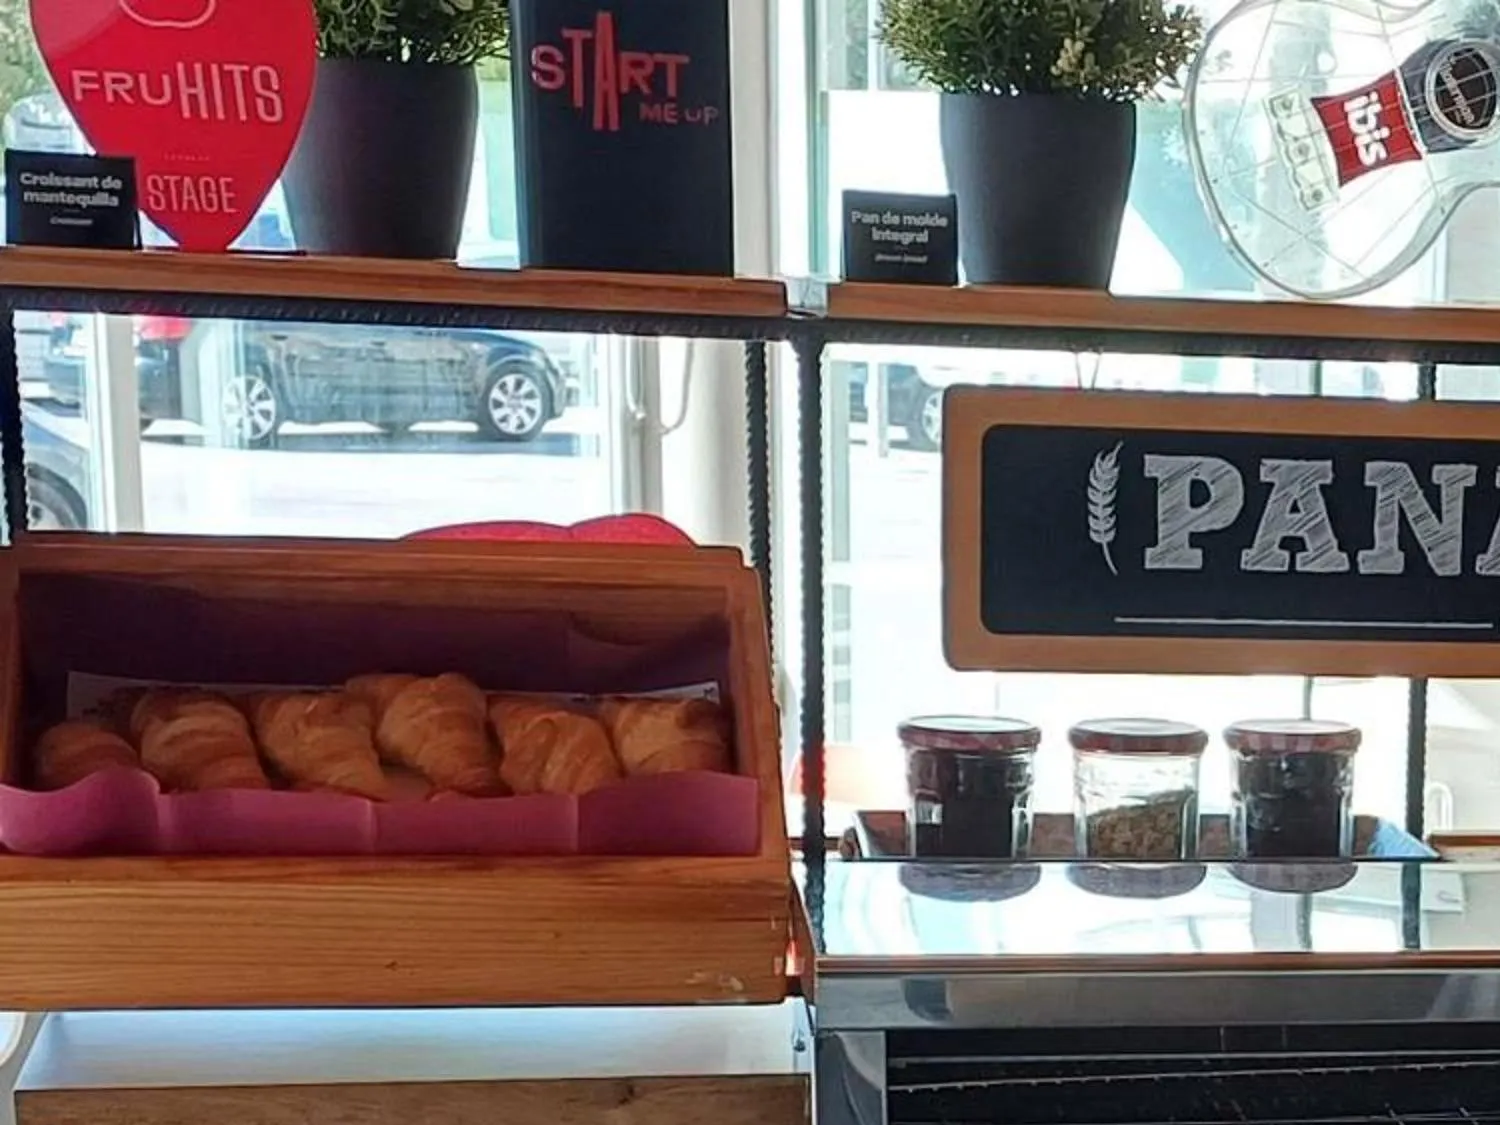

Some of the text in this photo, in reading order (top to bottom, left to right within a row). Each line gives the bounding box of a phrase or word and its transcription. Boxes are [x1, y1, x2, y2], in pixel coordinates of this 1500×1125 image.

[531, 11, 690, 131] START
[71, 61, 283, 123] FRUHITS
[639, 102, 719, 125] ME UP
[1343, 91, 1391, 167] ibis
[20, 172, 122, 190] Croissant de
[146, 174, 237, 213] STAGE
[23, 191, 119, 208] mantequilla
[851, 210, 948, 228] Pan de molde
